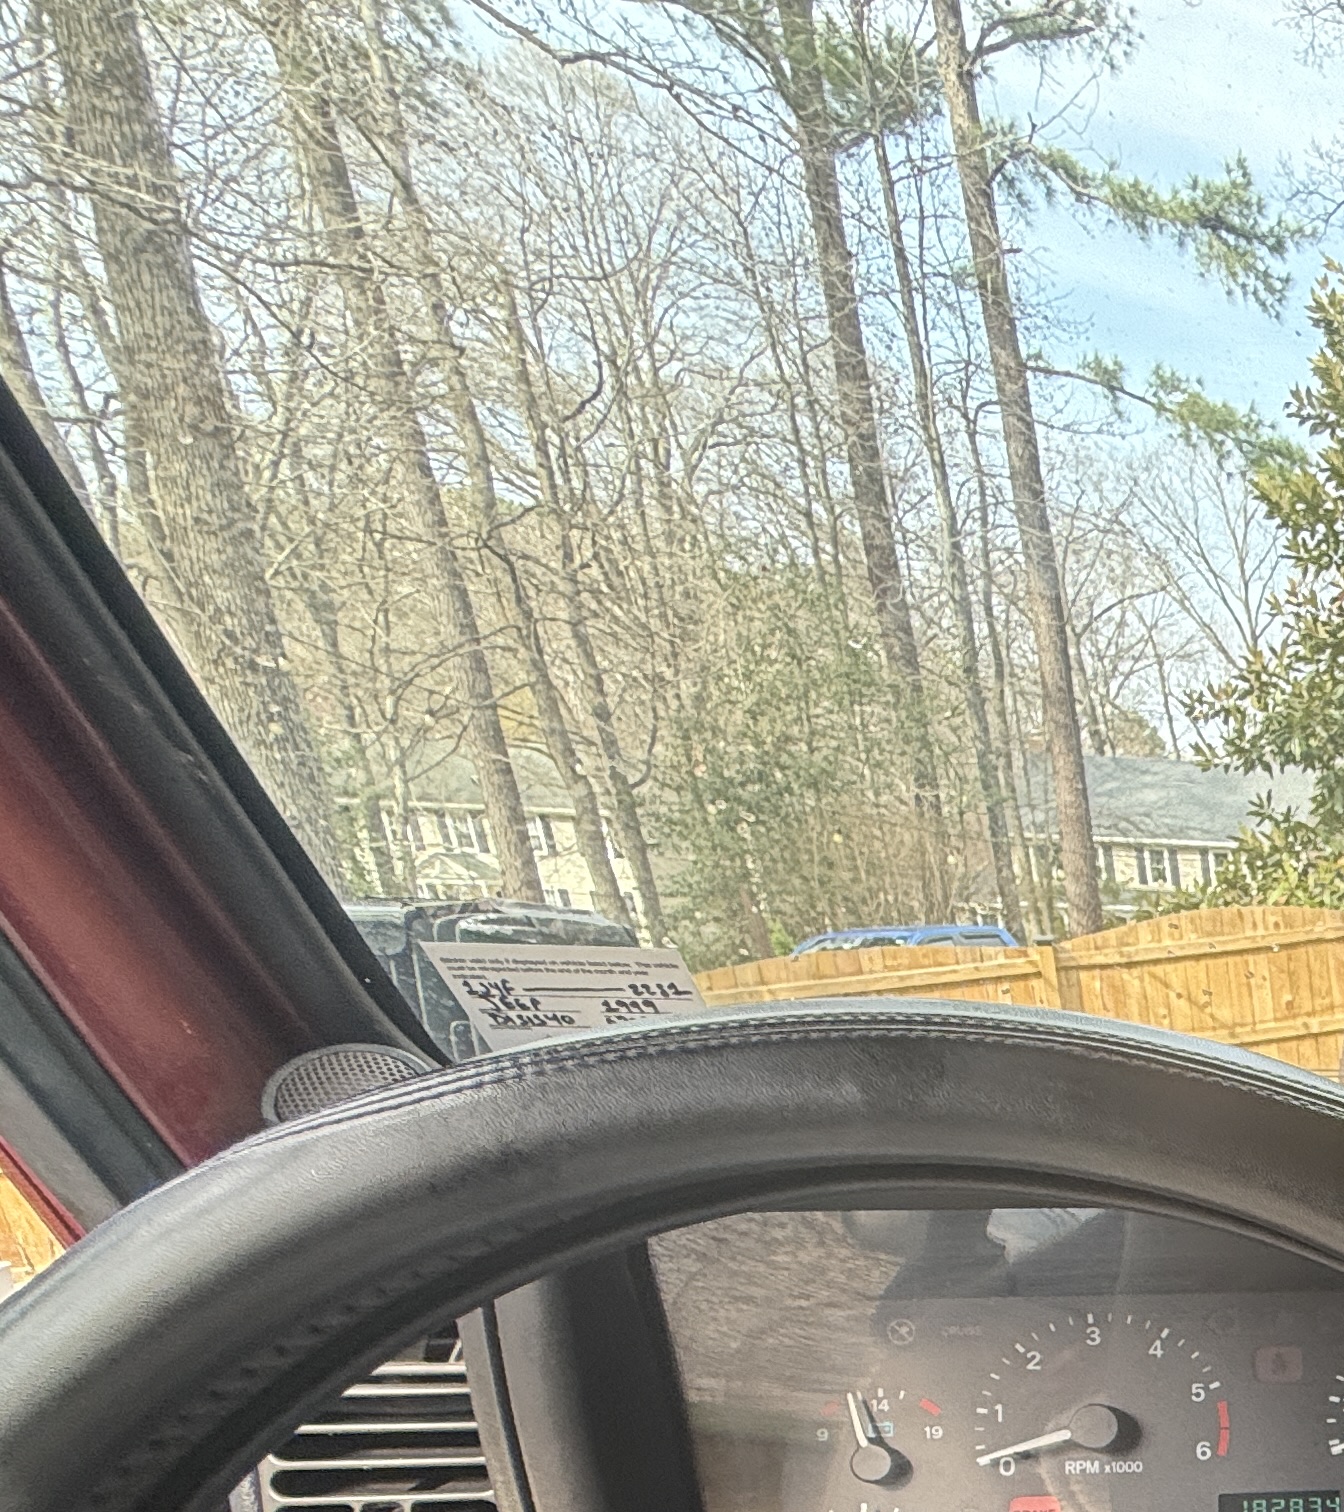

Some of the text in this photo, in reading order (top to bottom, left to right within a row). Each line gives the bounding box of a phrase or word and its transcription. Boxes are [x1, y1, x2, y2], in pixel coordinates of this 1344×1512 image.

[1086, 1327, 1101, 1345] 3
[1148, 1340, 1164, 1358] 4
[1026, 1351, 1042, 1370] 2
[1191, 1383, 1206, 1402] 5
[871, 1399, 889, 1412] 14
[993, 1403, 1003, 1422] 1
[816, 1428, 828, 1442] 9
[925, 1426, 943, 1439] 19
[1196, 1441, 1211, 1461] 6
[999, 1457, 1016, 1476] 0
[1065, 1460, 1143, 1475] RPM x1000
